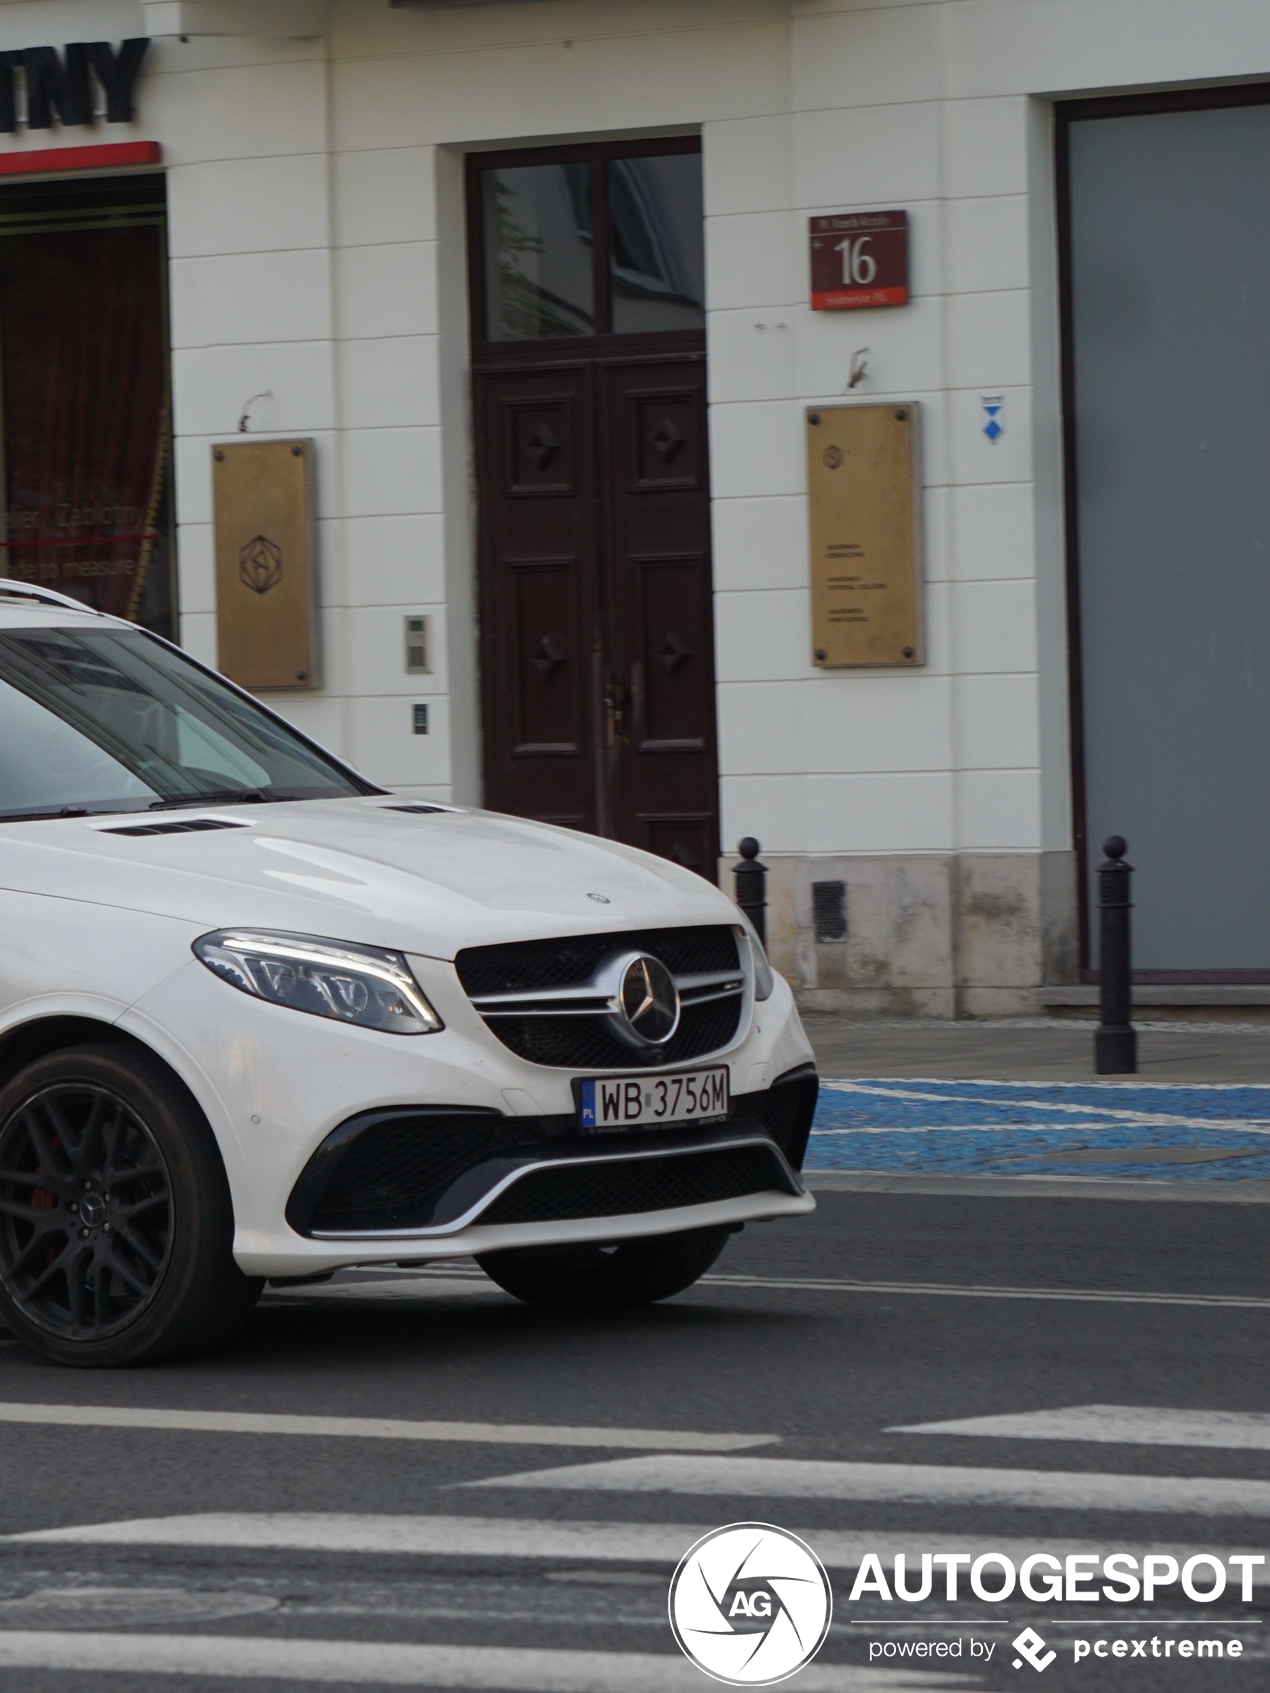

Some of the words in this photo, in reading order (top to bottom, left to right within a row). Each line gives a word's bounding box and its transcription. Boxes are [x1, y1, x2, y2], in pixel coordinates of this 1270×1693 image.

[833, 236, 877, 285] 16
[583, 1108, 594, 1120] PL
[602, 1082, 642, 1121] WB
[654, 1072, 725, 1118] 3756M
